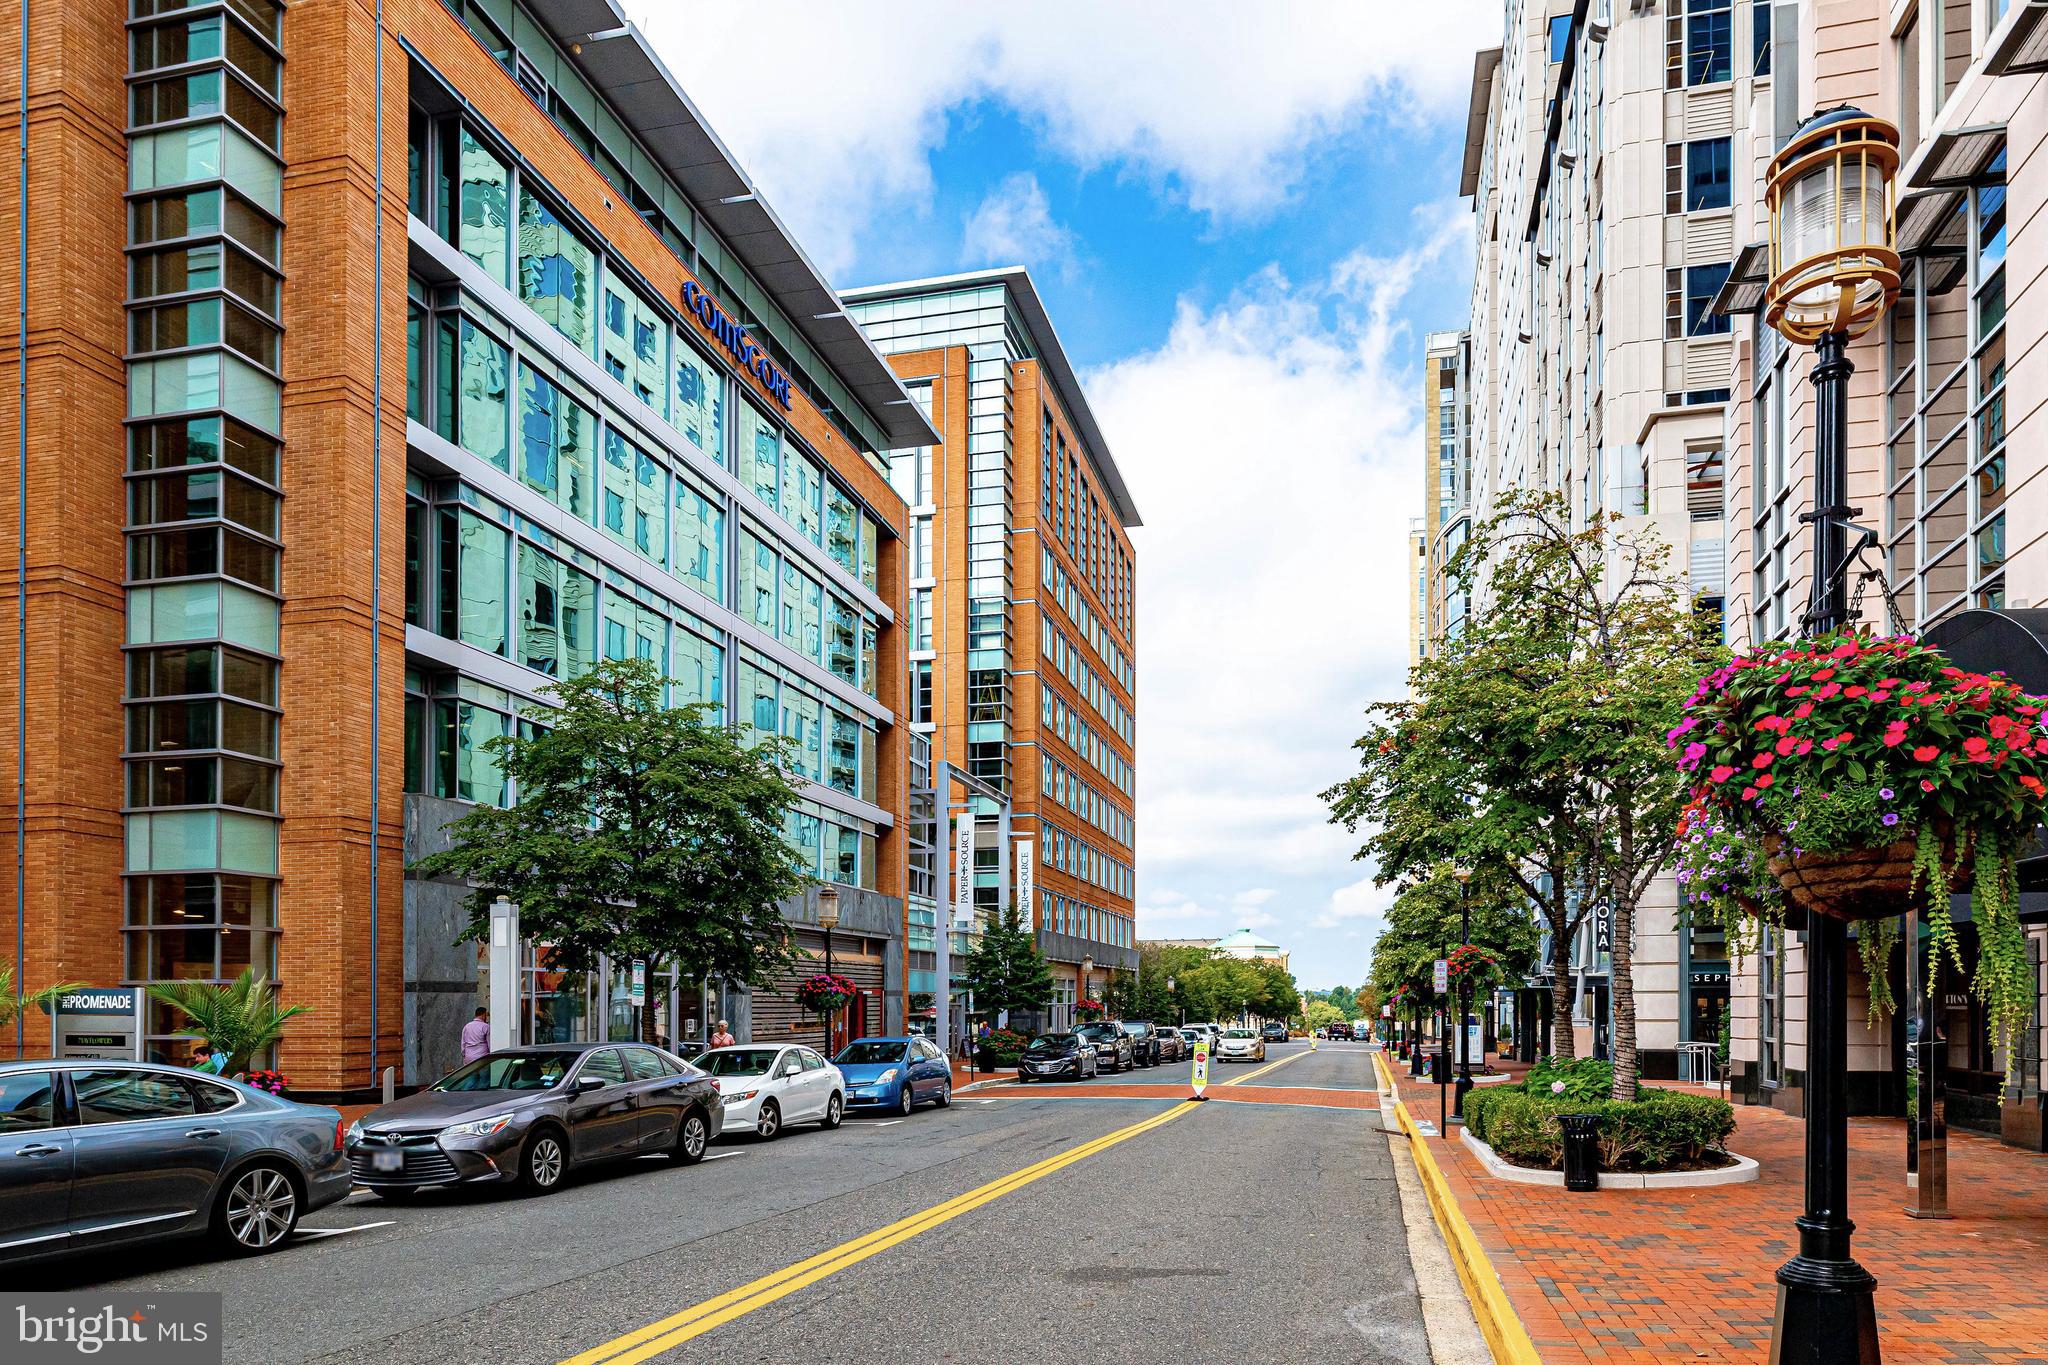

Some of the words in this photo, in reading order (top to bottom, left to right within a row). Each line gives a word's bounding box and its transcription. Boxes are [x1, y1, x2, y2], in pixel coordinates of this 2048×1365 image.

[960, 830, 969, 866] SOURCE
[1021, 852, 1029, 886] SOURCE
[960, 875, 969, 904] PAPER
[70, 995, 131, 1009] PROMENADE
